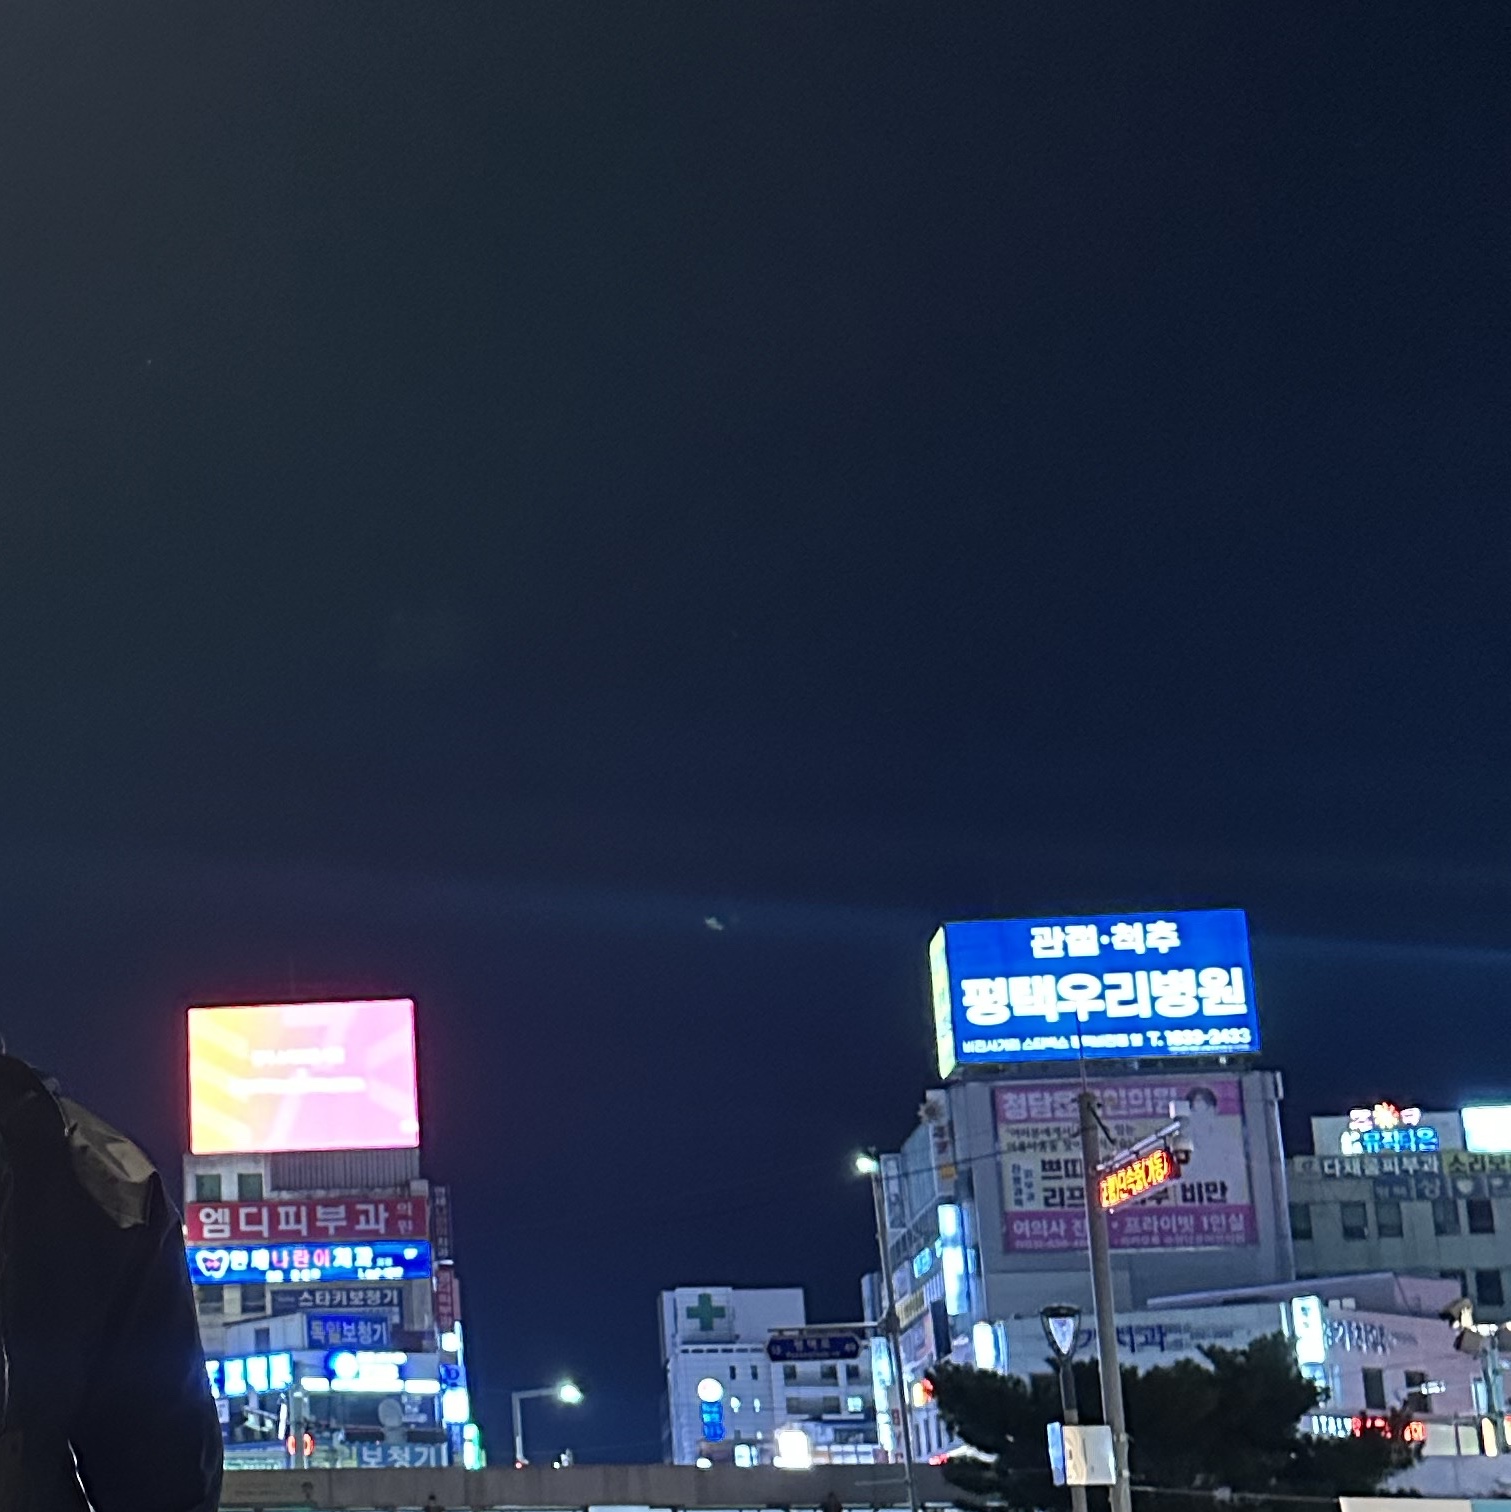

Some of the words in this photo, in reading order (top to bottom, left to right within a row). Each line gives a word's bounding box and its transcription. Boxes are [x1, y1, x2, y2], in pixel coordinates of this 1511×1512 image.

[960, 966, 1248, 1026] 평택우리병원
[1180, 1181, 1228, 1204] 비만
[199, 1203, 389, 1240] 엠디피부과
[1013, 1218, 1066, 1238] 여의사
[298, 1289, 399, 1307] 스타키보청기
[309, 1319, 388, 1347] 독일보청기
